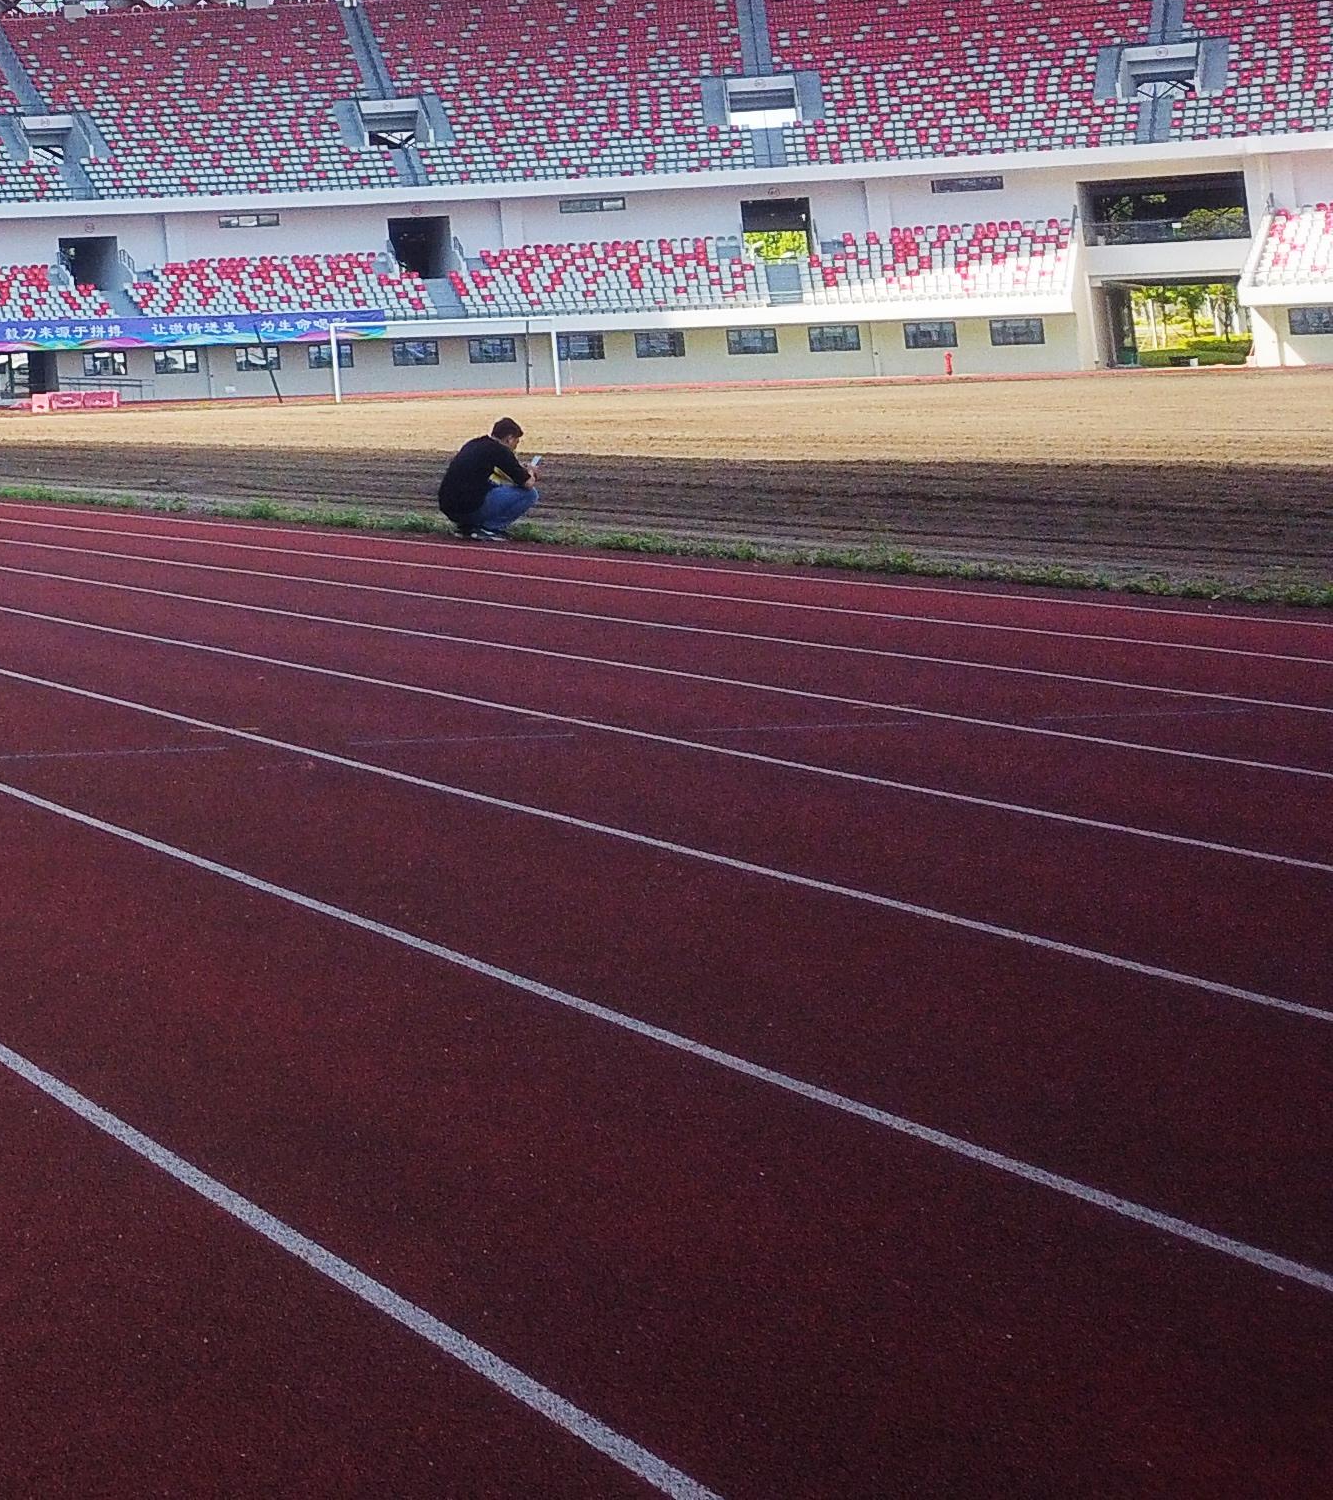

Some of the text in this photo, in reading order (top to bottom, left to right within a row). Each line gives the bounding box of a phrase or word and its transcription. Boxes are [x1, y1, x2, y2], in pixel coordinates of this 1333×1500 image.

[5, 324, 124, 341] 毅力来源于拼搏
